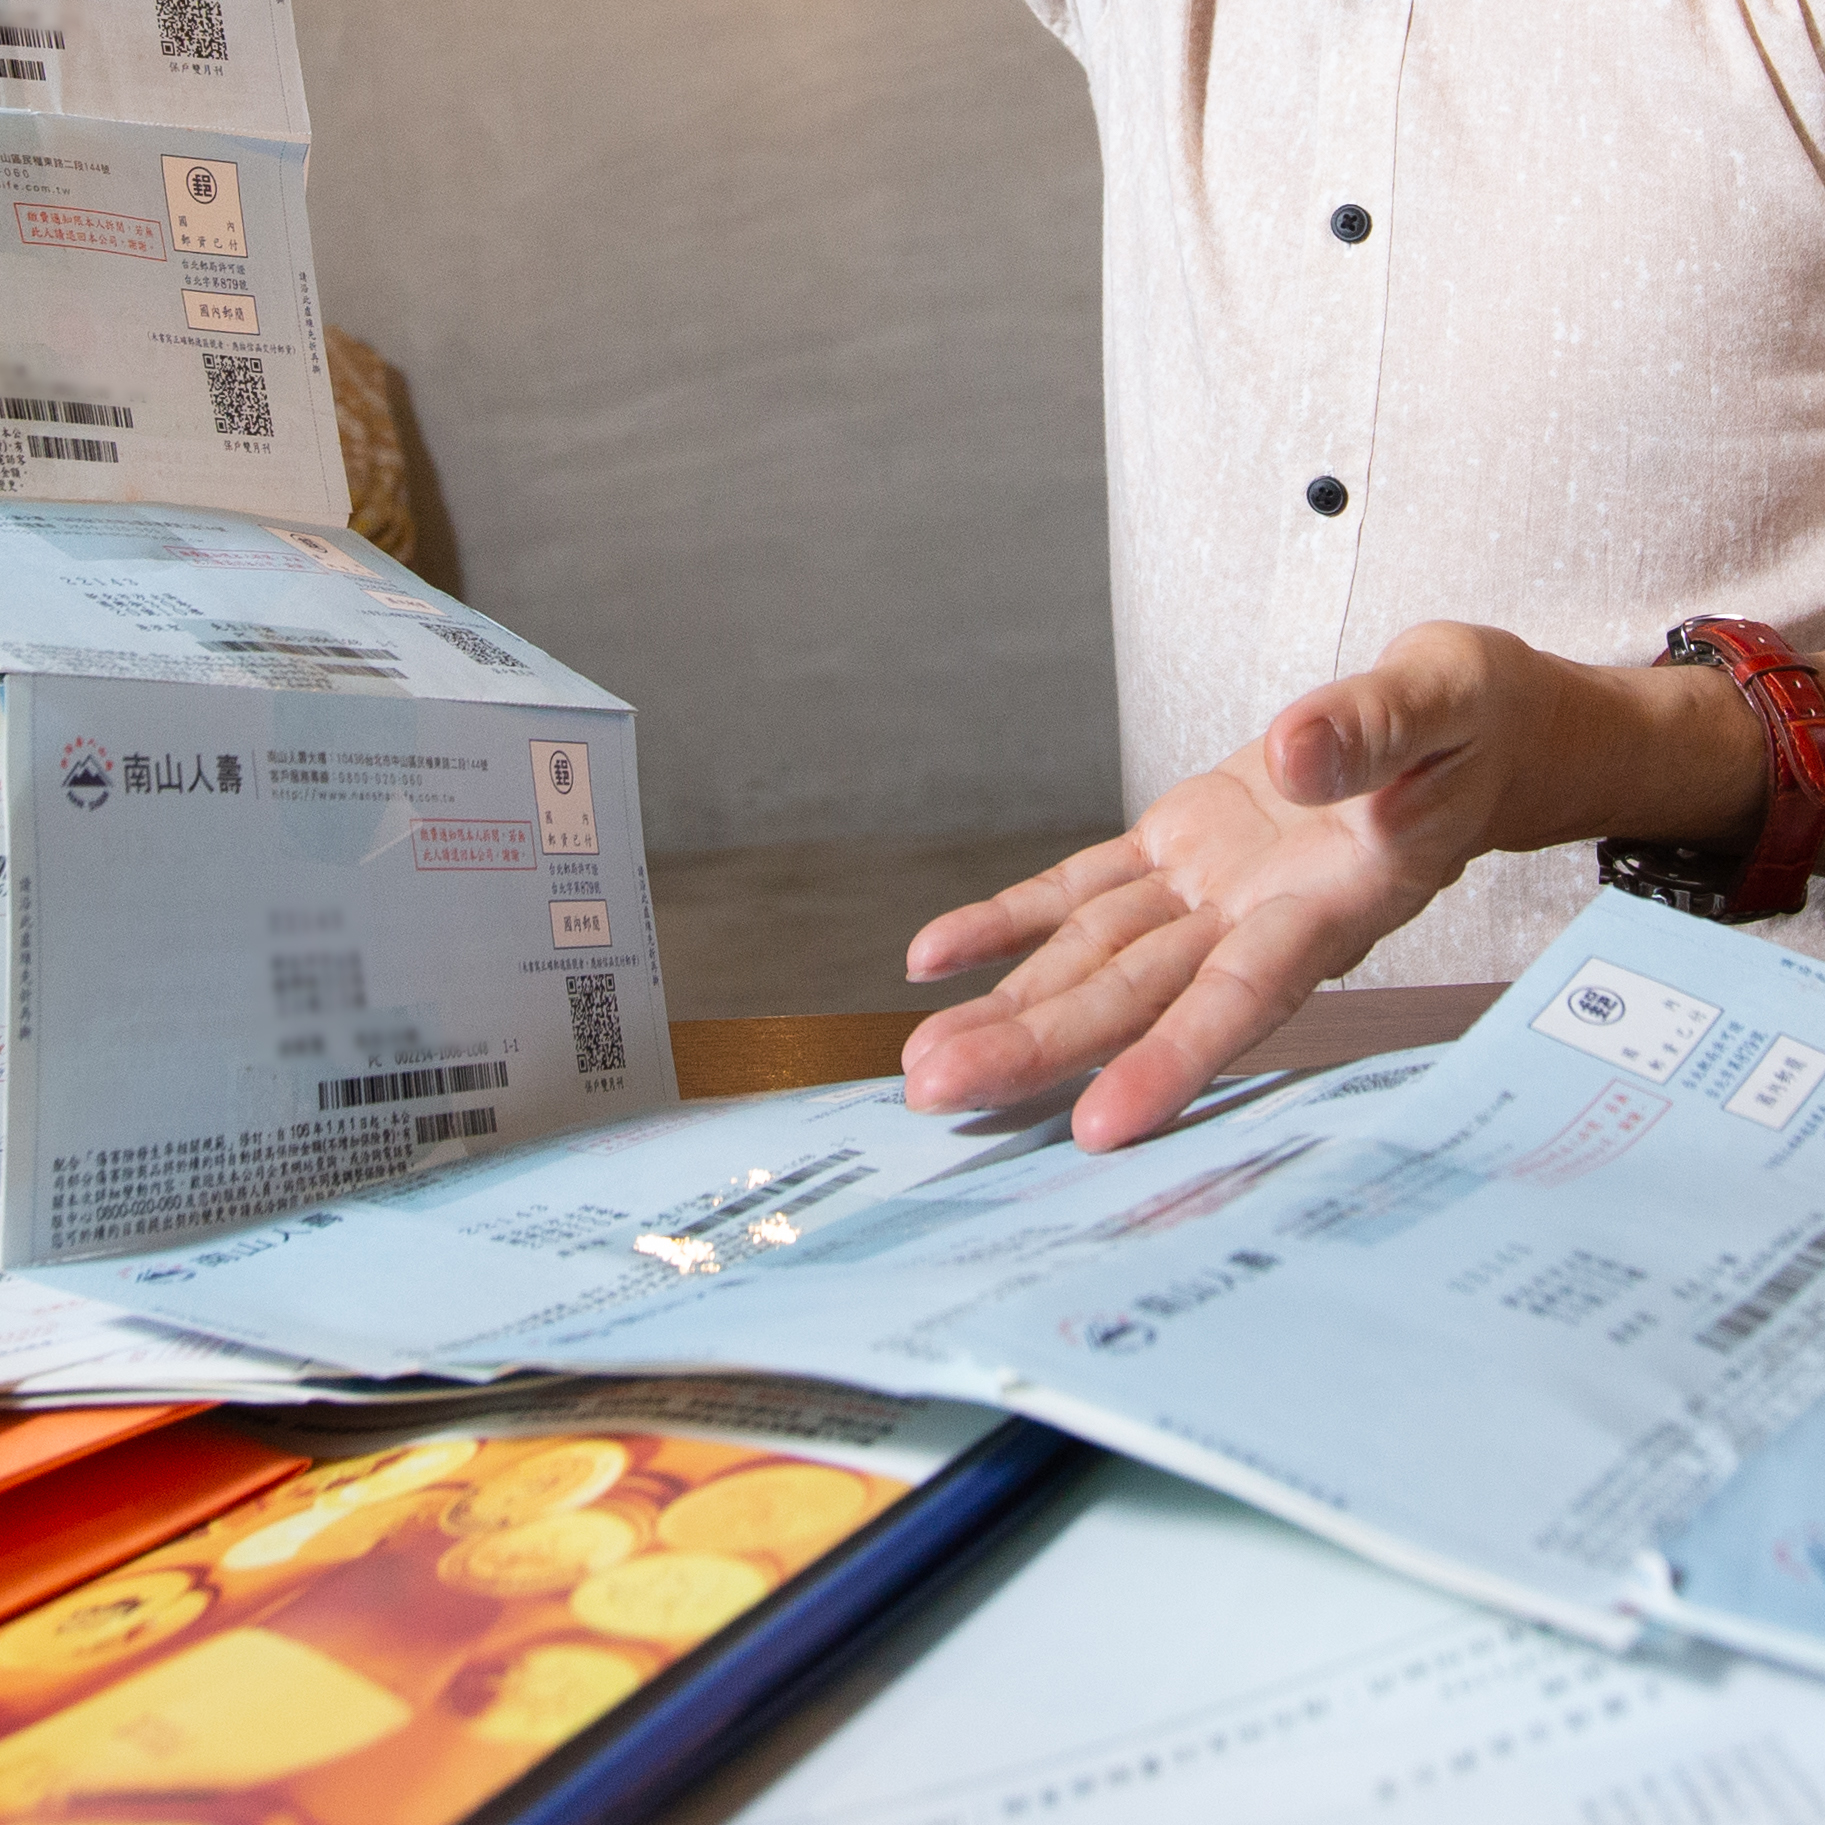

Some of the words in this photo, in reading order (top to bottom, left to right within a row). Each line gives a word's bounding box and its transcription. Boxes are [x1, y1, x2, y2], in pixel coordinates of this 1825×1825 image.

[169, 60, 224, 76] 保戶雙月刊
[184, 275, 248, 291] 台北字第879號
[199, 304, 245, 321] 國內郵簡
[223, 439, 271, 454] 保戶雙月刊
[122, 753, 243, 796] 南山人壽
[563, 915, 600, 934] 國內郵簡
[504, 1038, 519, 1053] 1-1
[96, 1194, 182, 1221] 0800-020-060
